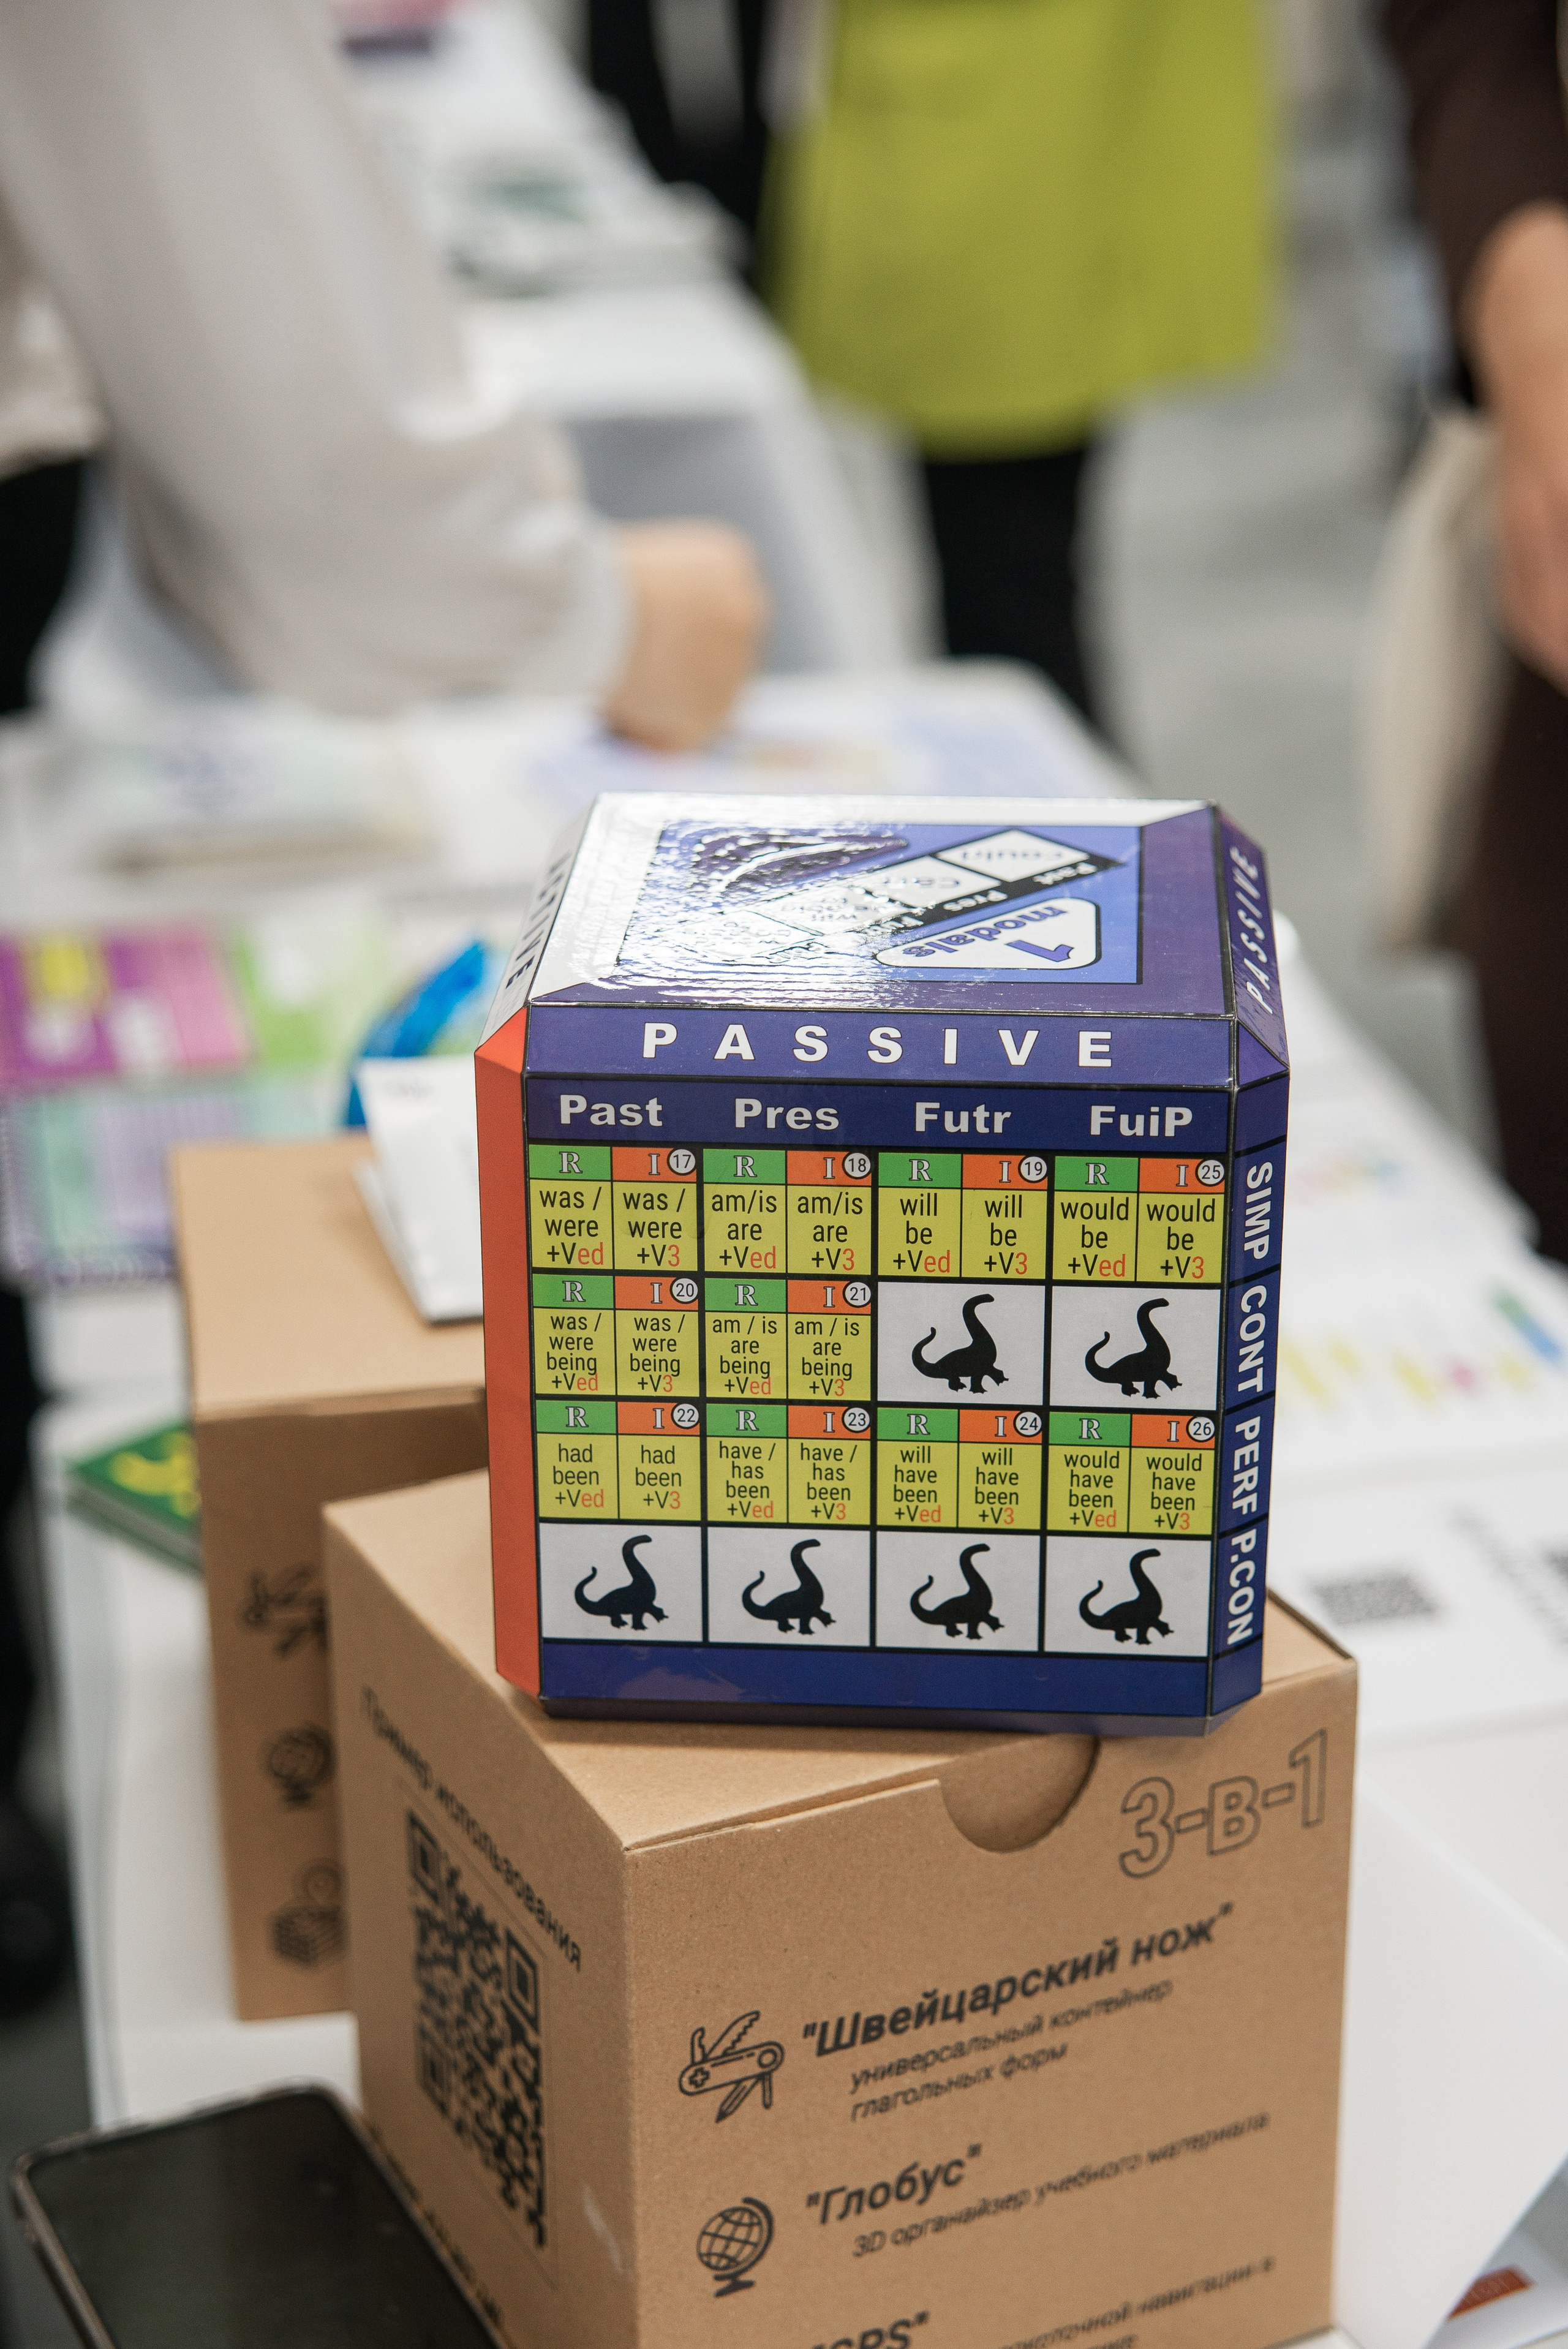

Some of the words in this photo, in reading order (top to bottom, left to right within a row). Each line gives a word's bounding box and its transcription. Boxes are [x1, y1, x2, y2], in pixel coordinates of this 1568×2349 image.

[902, 907, 1069, 957] modals
[1229, 845, 1273, 1014] PASSIVE
[1003, 939, 1075, 962] 1
[643, 1023, 1111, 1066] PASSIVE
[560, 1095, 662, 1126] Past
[736, 1099, 839, 1129] Pres
[916, 1103, 1011, 1133] Futr
[1091, 1106, 1192, 1136] FuiP
[559, 1152, 582, 1173] R
[649, 1154, 660, 1175] I
[673, 1154, 692, 1168] 17
[734, 1155, 757, 1177] R
[823, 1157, 835, 1178] I
[848, 1158, 866, 1172] 18
[909, 1159, 932, 1182] R
[999, 1161, 1011, 1183] I
[1025, 1161, 1042, 1176] 19
[1086, 1163, 1109, 1185] R
[1176, 1164, 1188, 1186] I
[1202, 1165, 1221, 1179] 25
[539, 1190, 584, 1208] was
[623, 1193, 668, 1210] was
[712, 1190, 777, 1214] am/is
[797, 1191, 862, 1216] am/is
[900, 1193, 937, 1216] will
[984, 1194, 1022, 1218] will
[1060, 1196, 1129, 1221] would
[1147, 1198, 1215, 1222] would
[1244, 1162, 1272, 1259] SIMP
[545, 1219, 598, 1237] were
[628, 1221, 682, 1239] were
[728, 1223, 762, 1241] are
[813, 1225, 848, 1243] are
[906, 1220, 932, 1245] be
[990, 1222, 1017, 1246] be
[1081, 1224, 1108, 1249] be
[1167, 1226, 1194, 1251] be
[547, 1242, 603, 1265] +Ved
[637, 1244, 679, 1267] +V3
[719, 1246, 775, 1269] +Ved
[812, 1248, 854, 1270] +V3
[893, 1250, 950, 1273] +Ved
[984, 1252, 1027, 1275] +V3
[1068, 1254, 1125, 1277] +Ved
[1160, 1256, 1204, 1279] +V3
[562, 1281, 586, 1302] R
[650, 1283, 662, 1303] I
[676, 1283, 694, 1297] 20
[735, 1284, 758, 1306] R
[824, 1286, 835, 1308] I
[850, 1287, 865, 1301] 21
[551, 1316, 587, 1330] was
[634, 1318, 671, 1332] was
[713, 1319, 740, 1333] am
[763, 1316, 777, 1334] is
[795, 1321, 822, 1335] am
[845, 1318, 859, 1336] is
[549, 1337, 594, 1351] were
[632, 1338, 677, 1352] were
[731, 1340, 759, 1354] are
[813, 1342, 842, 1356] are
[1238, 1286, 1267, 1392] CONT
[547, 1352, 598, 1376] being
[630, 1353, 680, 1377] being
[720, 1355, 771, 1379] being
[802, 1357, 852, 1381] being
[552, 1373, 598, 1391] +Ved
[638, 1374, 673, 1392] +V3
[725, 1376, 771, 1395] +Ved
[809, 1378, 844, 1397] +V3
[566, 1406, 589, 1428] R
[652, 1408, 664, 1429] I
[677, 1408, 695, 1422] 22
[736, 1410, 759, 1431] R
[824, 1412, 835, 1433] I
[848, 1412, 866, 1427] 23
[907, 1414, 930, 1435] R
[995, 1416, 1007, 1437] I
[1020, 1417, 1038, 1430] 24
[1079, 1418, 1102, 1440] R
[1167, 1421, 1179, 1442] I
[1193, 1422, 1211, 1436] 26
[559, 1443, 592, 1463] had
[641, 1444, 675, 1464] had
[720, 1441, 762, 1460] have
[801, 1442, 843, 1461] have
[900, 1446, 930, 1463] will
[982, 1447, 1012, 1466] will
[1064, 1450, 1120, 1469] would
[732, 1461, 764, 1479] has
[813, 1462, 845, 1481] has
[1146, 1453, 1202, 1471] would
[1233, 1416, 1260, 1514] PERF
[553, 1466, 599, 1485] been
[635, 1467, 681, 1487] been
[895, 1465, 937, 1484] have
[976, 1466, 1019, 1485] have
[1070, 1469, 1114, 1488] have
[1152, 1471, 1196, 1491] have
[555, 1489, 603, 1507] +Ved
[726, 1480, 769, 1498] been
[807, 1482, 850, 1501] been
[894, 1484, 937, 1503] been
[975, 1486, 1019, 1505] been
[1069, 1489, 1113, 1508] been
[643, 1491, 680, 1509] +V3
[728, 1501, 773, 1518] +Ved
[1151, 1491, 1195, 1510] been
[811, 1503, 845, 1520] +V3
[895, 1505, 941, 1523] +Ved
[979, 1507, 1014, 1525] +V3
[1069, 1510, 1116, 1528] +Ved
[1155, 1512, 1189, 1530] +V3
[1227, 1529, 1256, 1644] P.CON
[803, 1937, 1120, 2056] "Швейцарский
[1131, 1902, 1233, 1966] нож"
[850, 2015, 1044, 2094] универсальный
[1049, 1979, 1174, 2030] контейнер
[850, 2065, 993, 2121] глагольных
[1000, 2042, 1069, 2080] форм
[806, 2143, 982, 2224] "Глобус"
[853, 2230, 887, 2257] 3D
[891, 2186, 1031, 2247] органайзер
